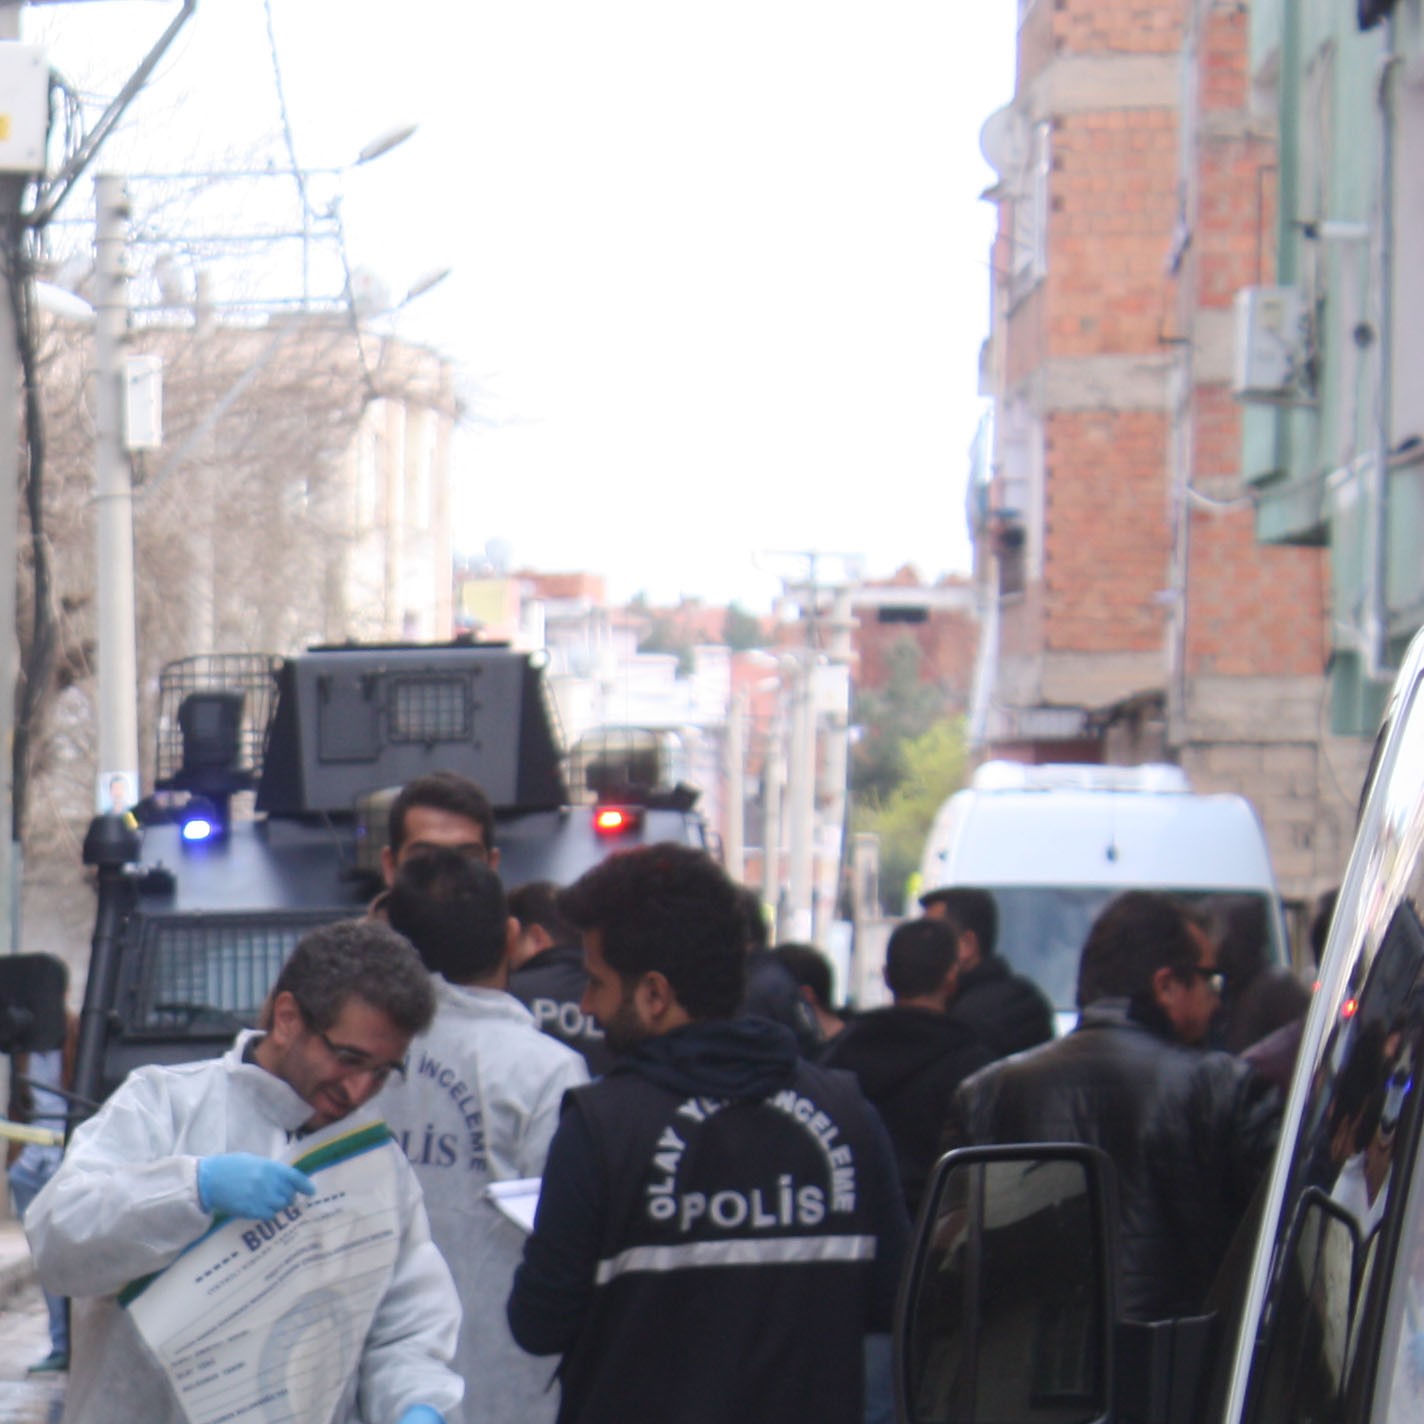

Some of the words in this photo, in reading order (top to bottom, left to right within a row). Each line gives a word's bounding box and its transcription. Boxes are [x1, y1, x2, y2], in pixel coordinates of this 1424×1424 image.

[533, 997, 606, 1039] POL
[395, 1123, 458, 1168] LİS
[648, 1126, 686, 1220] OLAY
[679, 1174, 826, 1232] POLİS
